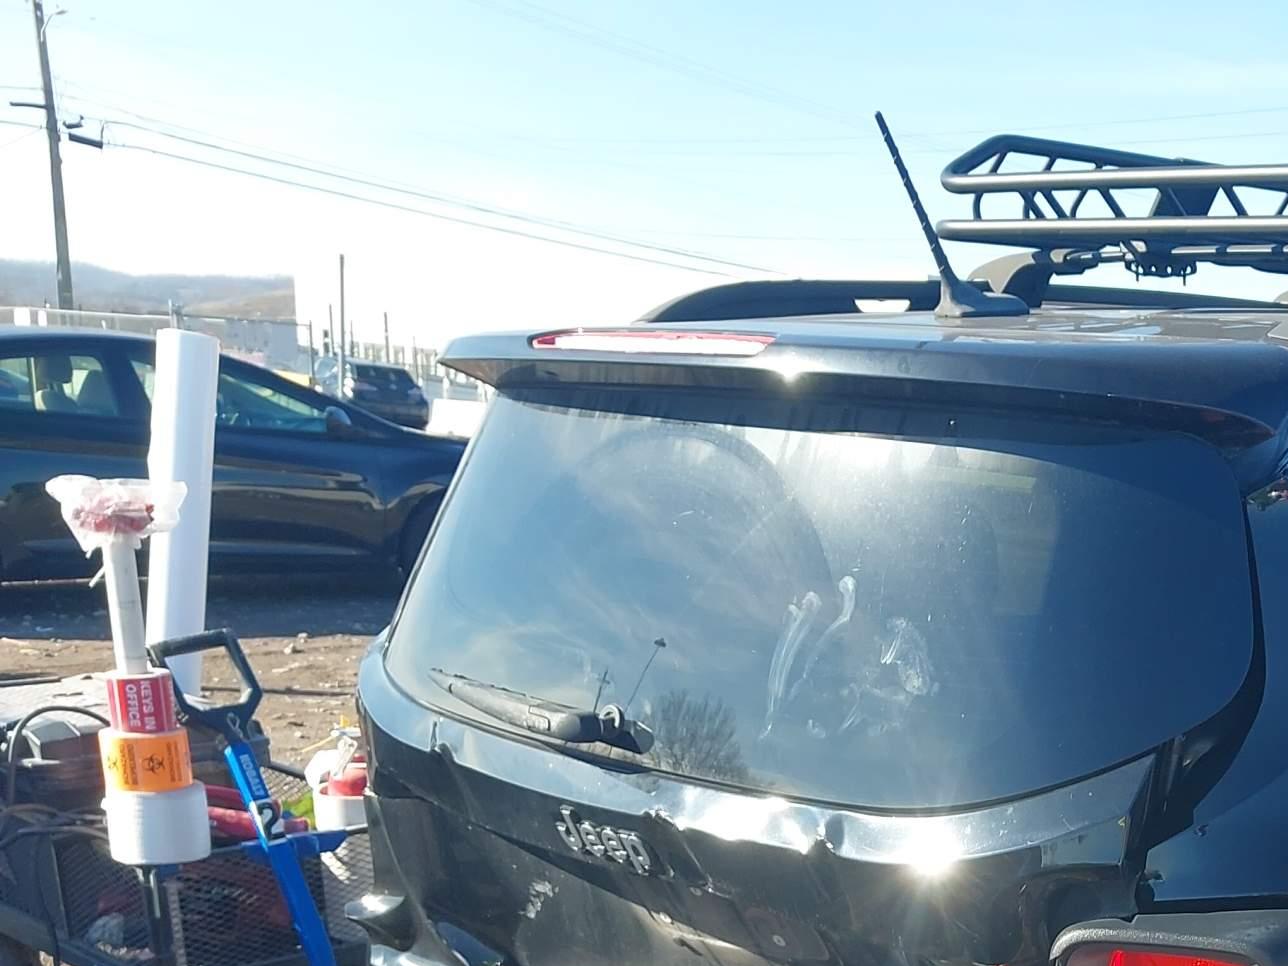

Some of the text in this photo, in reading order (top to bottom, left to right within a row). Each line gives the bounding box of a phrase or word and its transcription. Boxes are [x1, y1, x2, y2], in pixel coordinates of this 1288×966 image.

[125, 684, 141, 727] OFFICE
[141, 681, 156, 730] KEYS IN
[555, 804, 651, 876] Jeep
